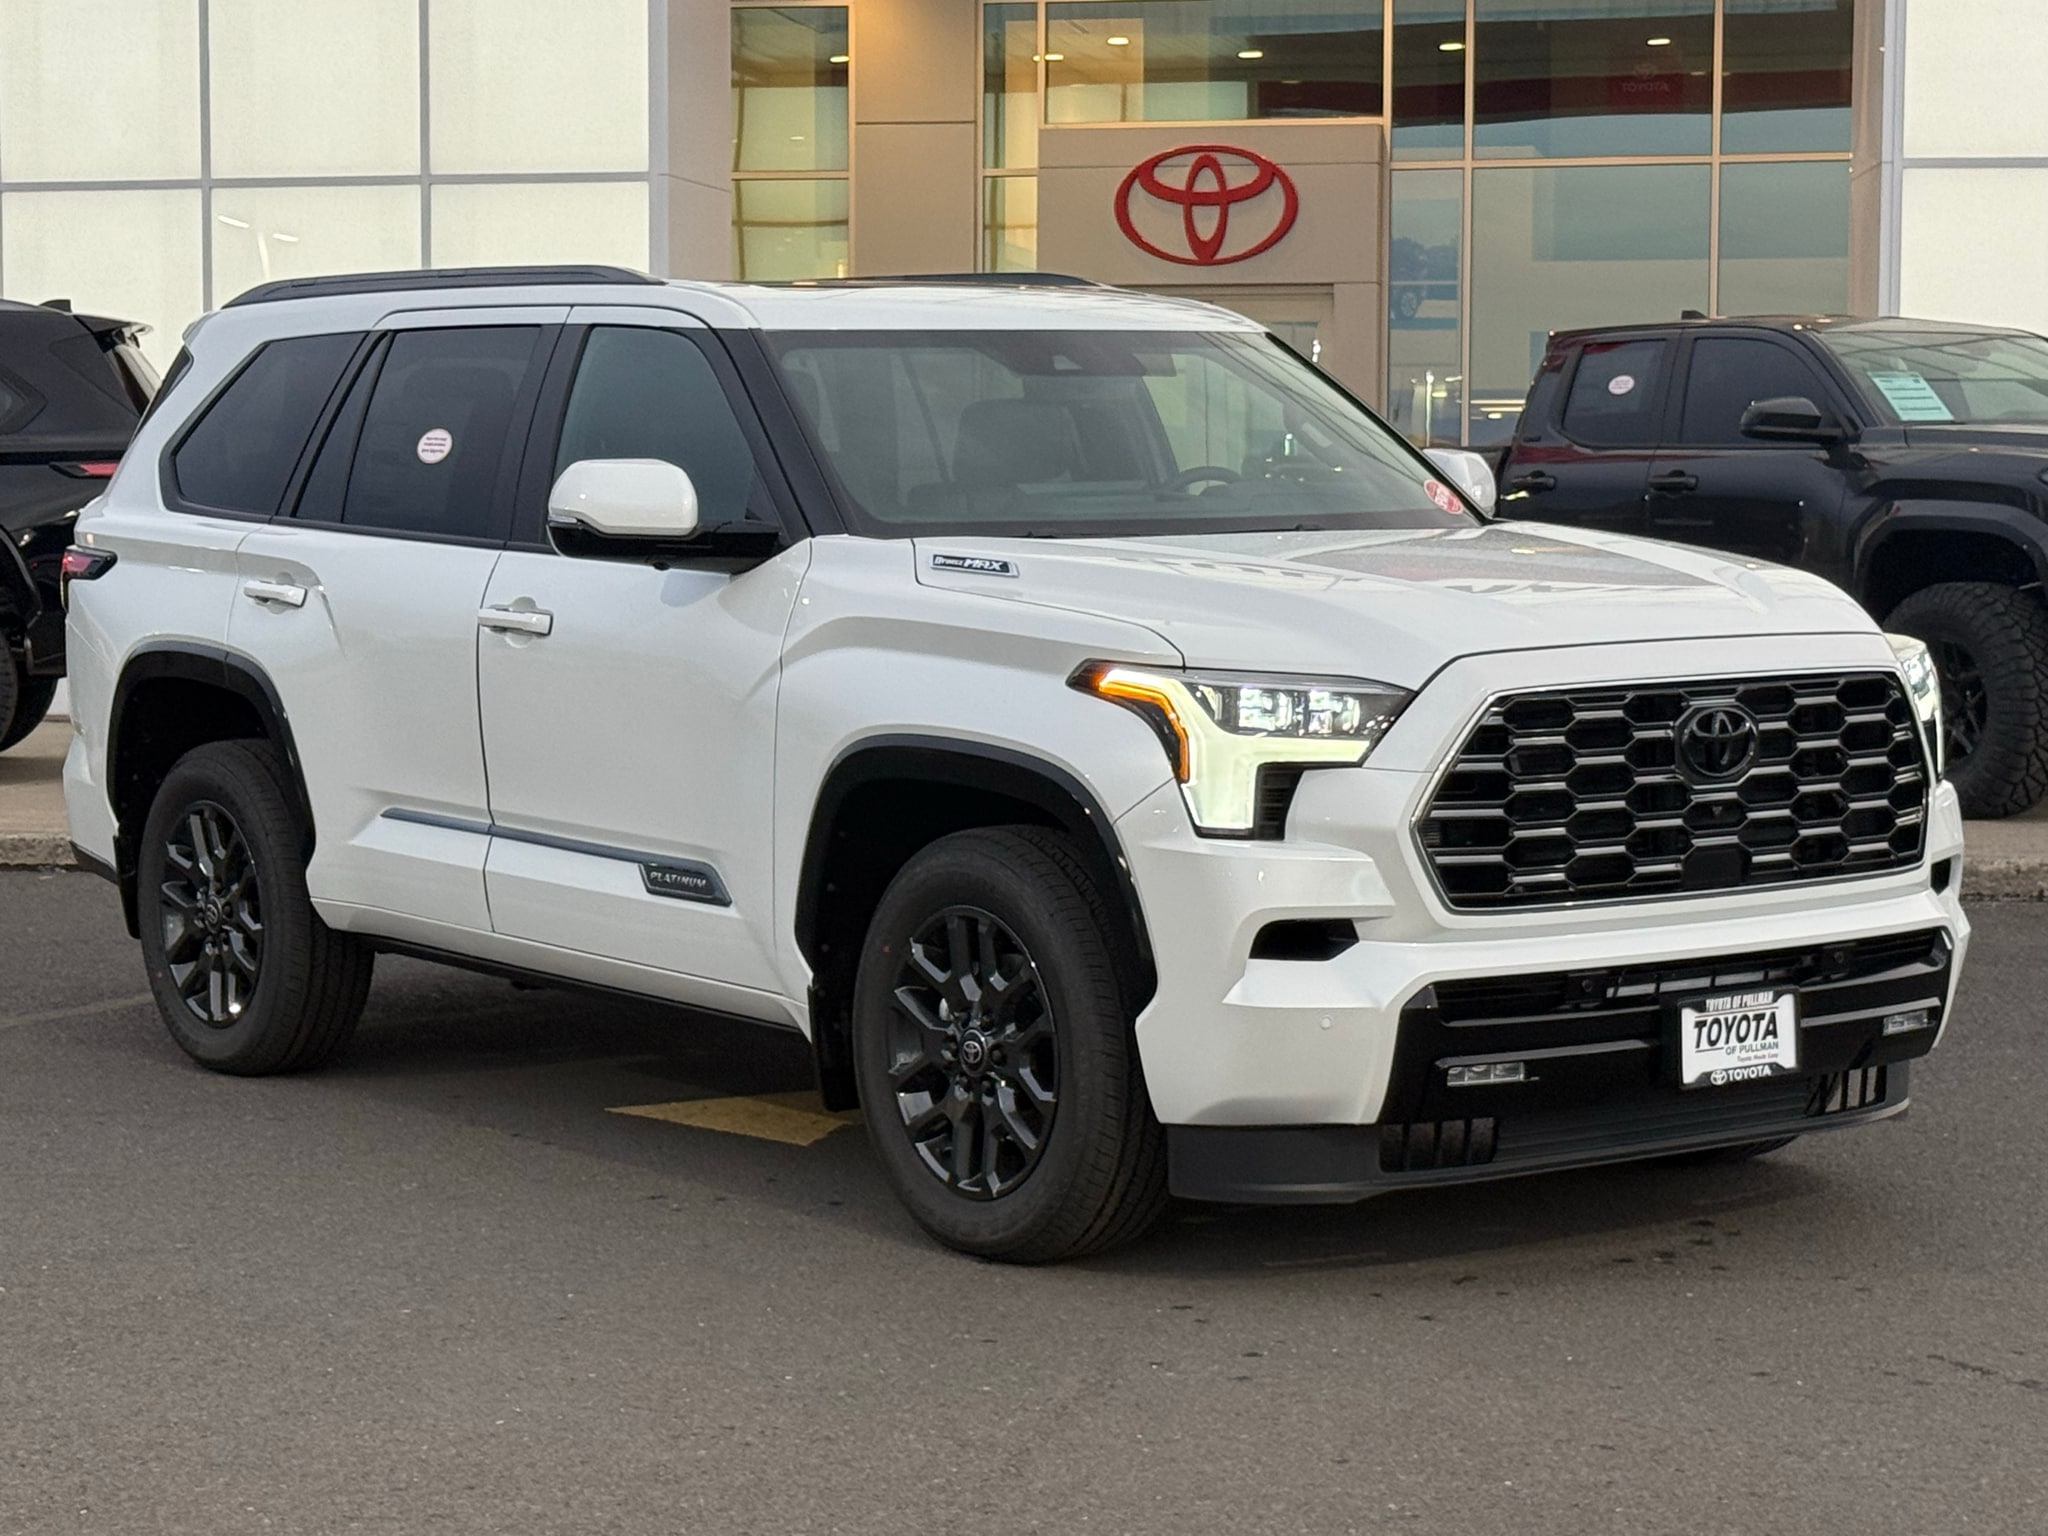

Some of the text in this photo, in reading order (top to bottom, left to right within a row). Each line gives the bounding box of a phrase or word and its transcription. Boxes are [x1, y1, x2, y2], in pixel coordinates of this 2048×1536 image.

[963, 558, 1004, 571] MAX
[650, 871, 706, 887] PLATINUM
[1706, 991, 1774, 1012] TOYOTA OF PULLMAN
[1694, 1011, 1778, 1049] TOYOTA
[1725, 1041, 1779, 1056] OF PULLMAN
[1727, 1064, 1772, 1081] TOYOTA
